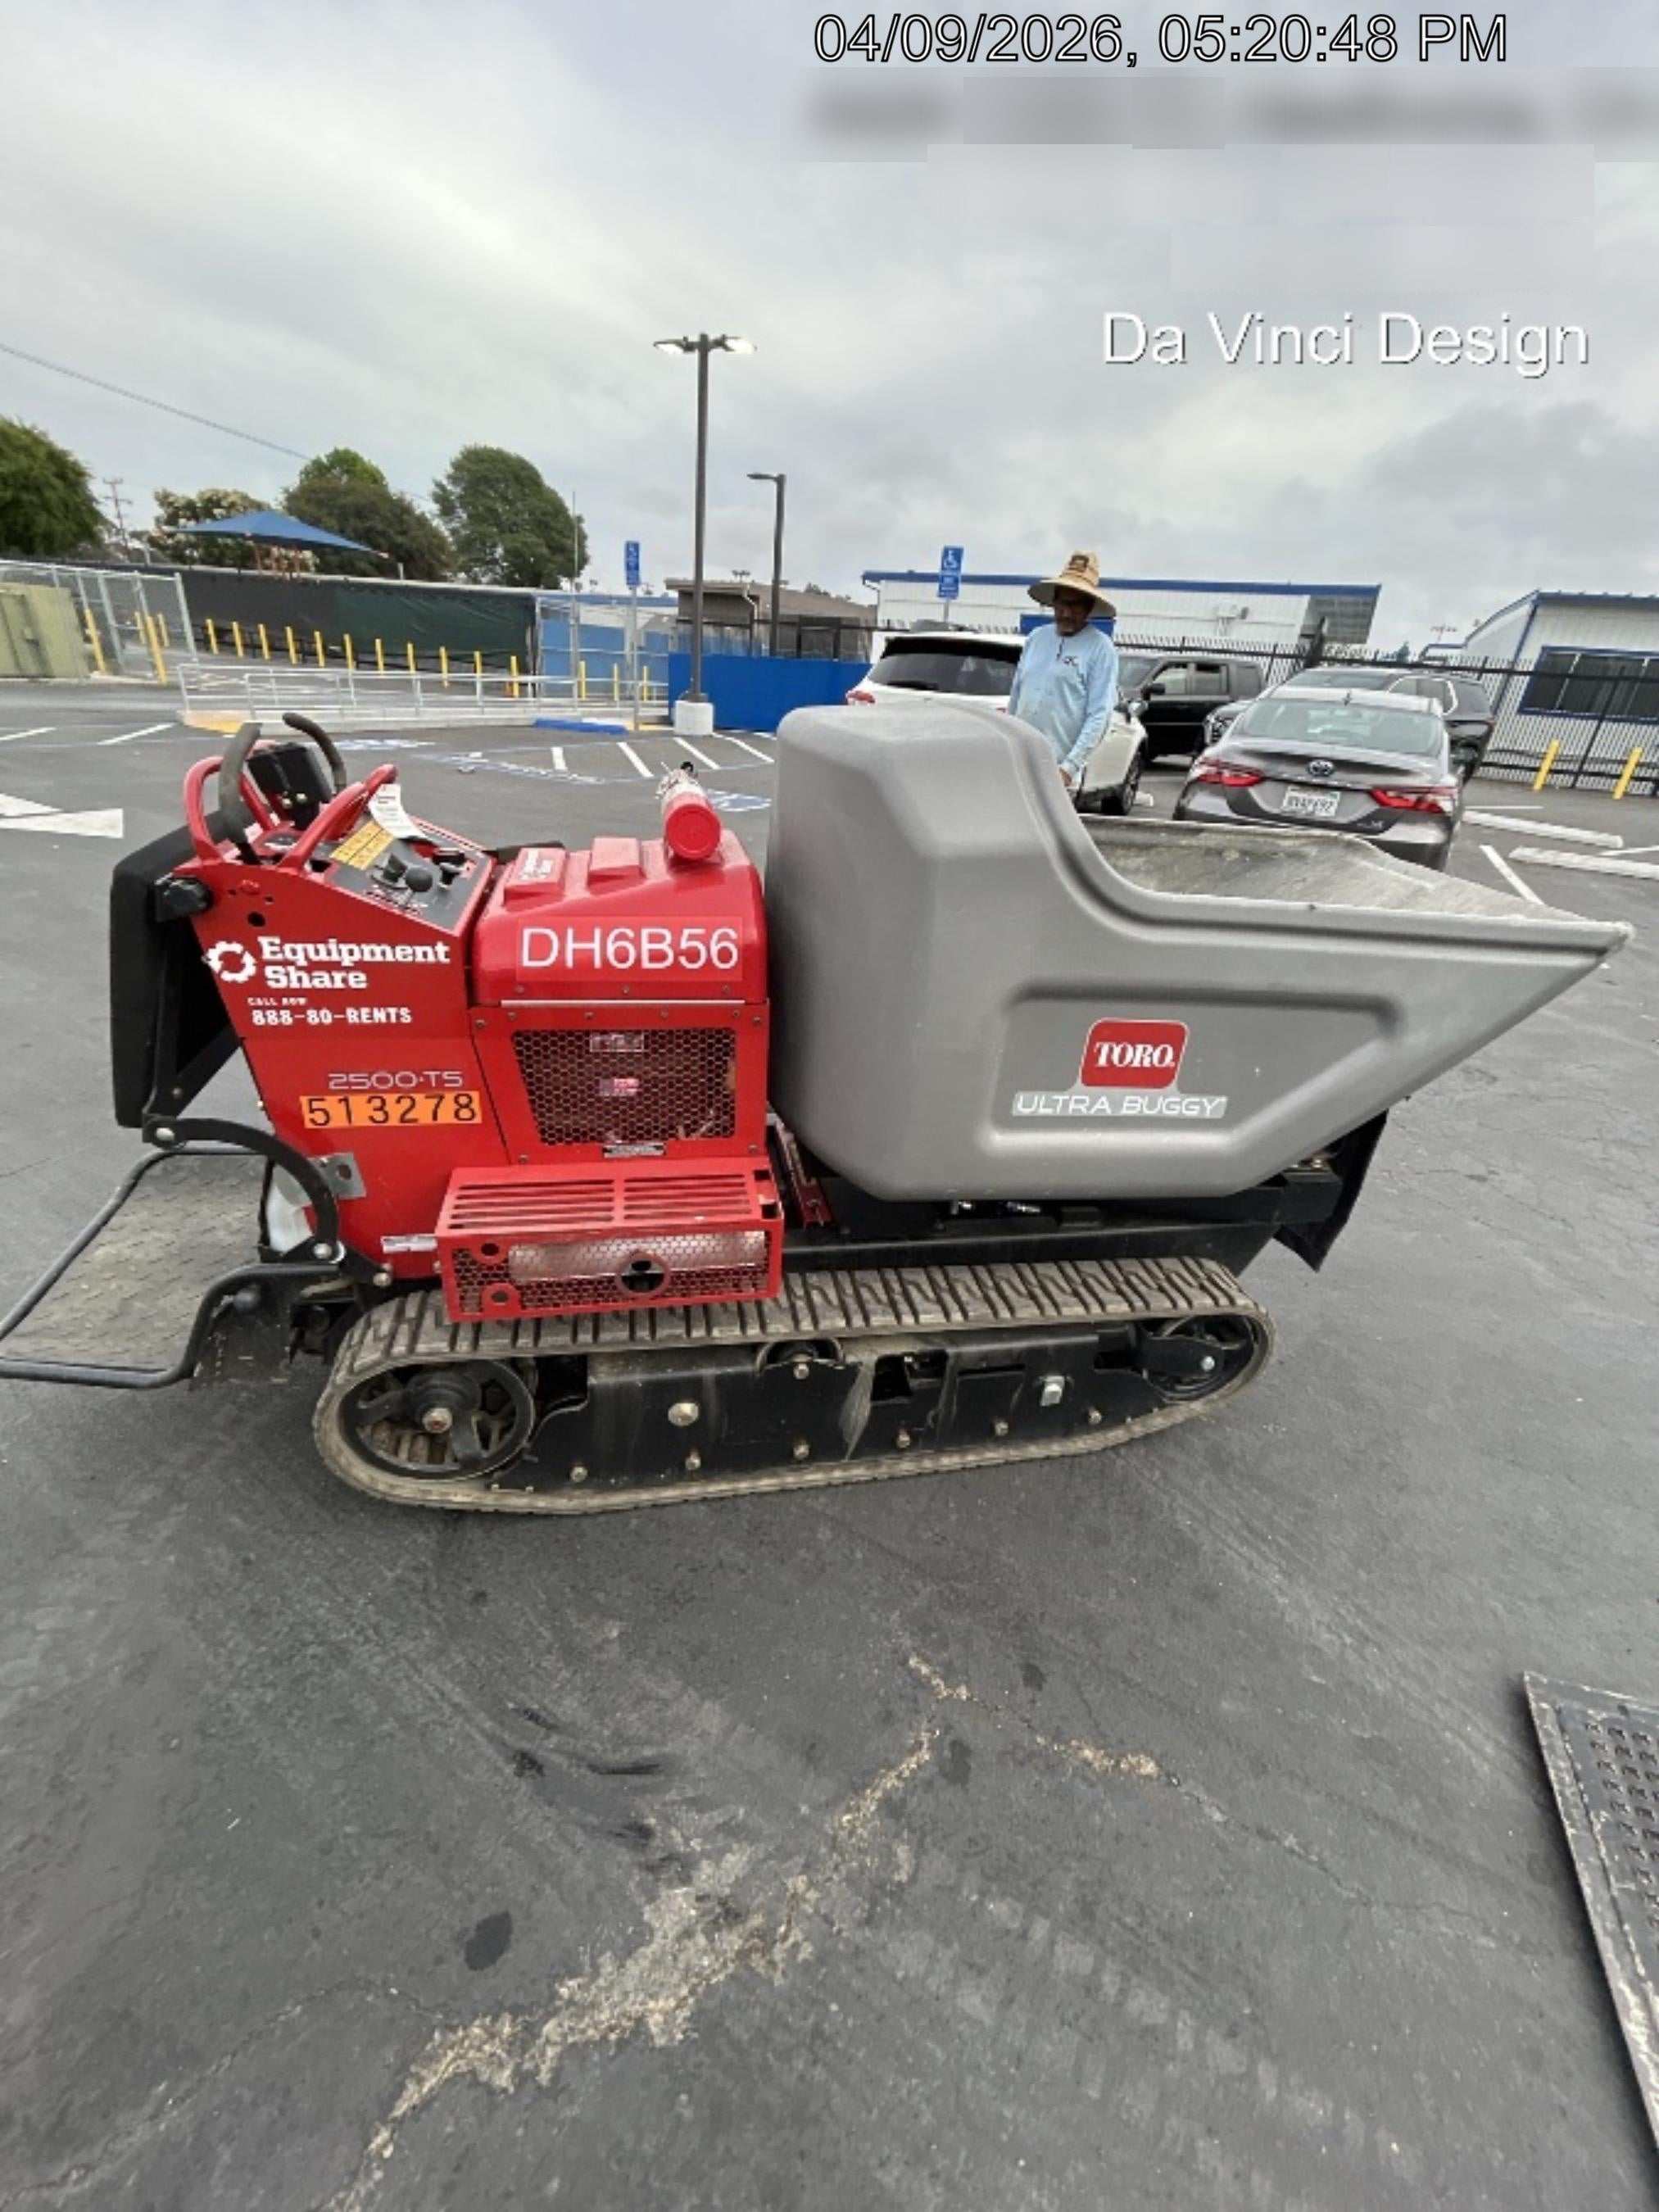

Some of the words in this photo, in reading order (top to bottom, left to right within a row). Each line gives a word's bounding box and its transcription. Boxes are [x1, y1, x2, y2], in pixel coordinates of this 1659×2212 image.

[257, 936, 451, 967] Equipment
[520, 927, 739, 969] DH6B56
[264, 965, 368, 989] Share
[252, 1007, 412, 1026] 888-80-RENTS
[1094, 1042, 1174, 1067] TORO
[307, 1093, 477, 1126] 513278
[1017, 1095, 1113, 1115] ULTRA
[1120, 1095, 1223, 1117] BUGGY
